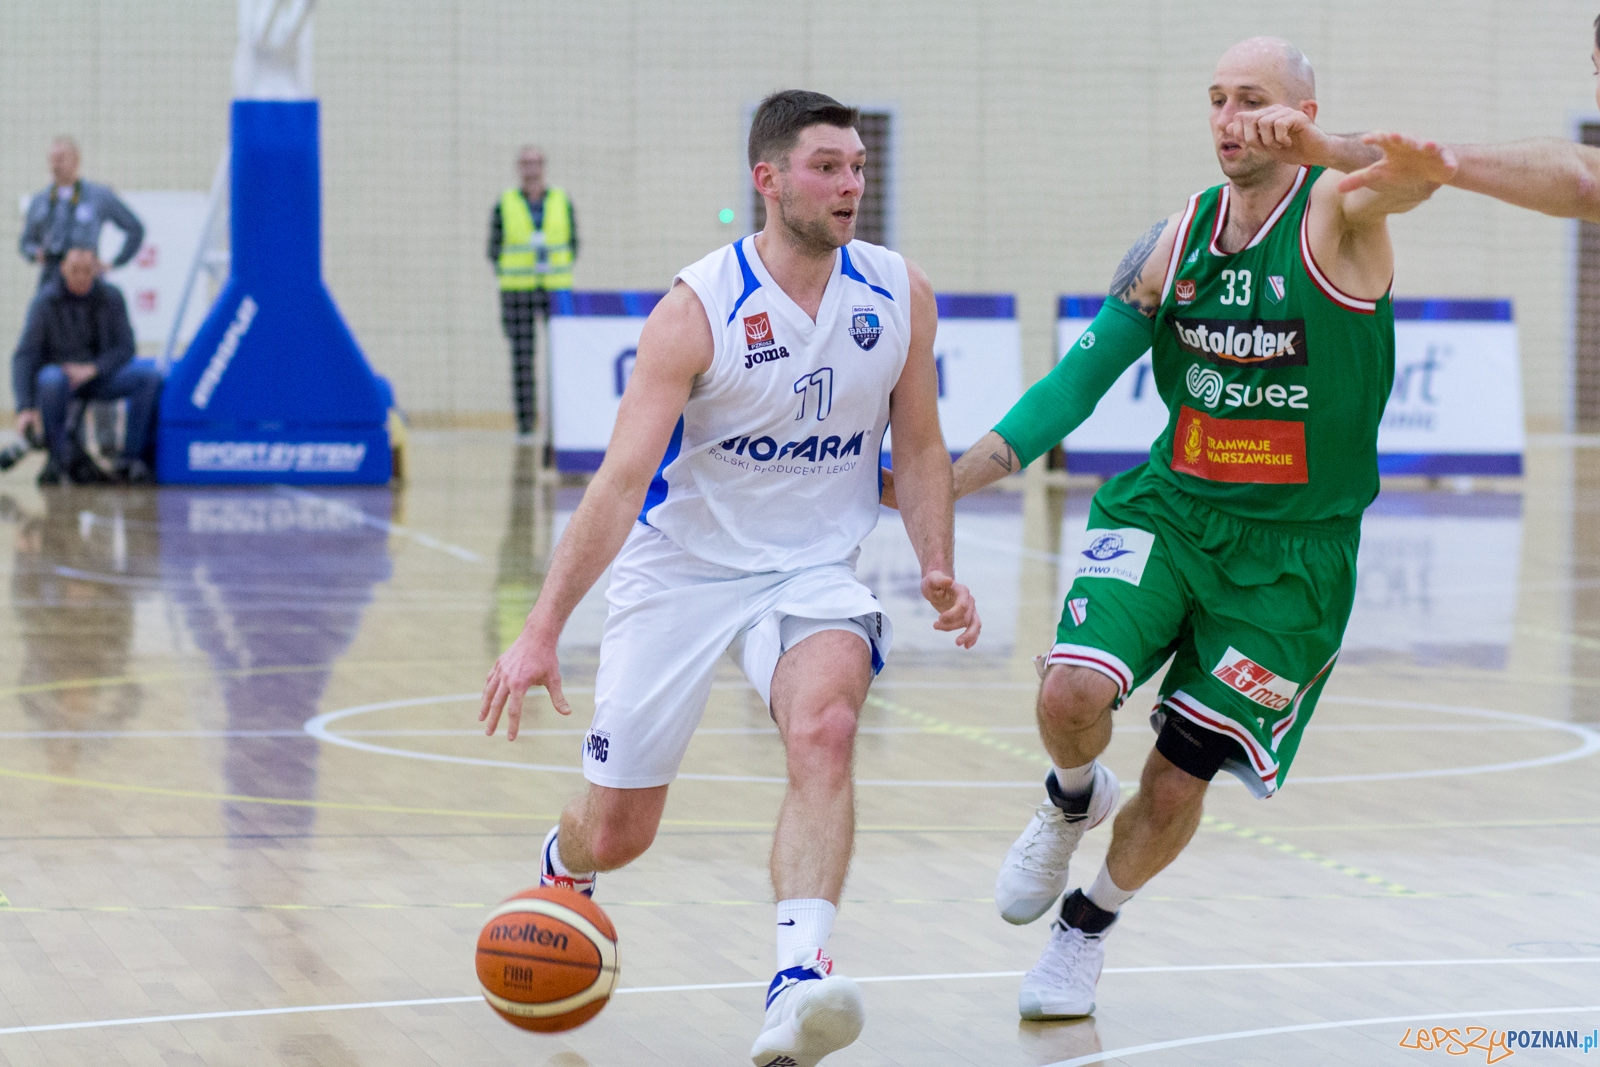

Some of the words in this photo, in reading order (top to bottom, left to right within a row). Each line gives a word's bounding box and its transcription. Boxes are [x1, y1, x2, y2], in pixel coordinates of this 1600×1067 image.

[1220, 269, 1252, 306] 33
[849, 326, 883, 336] BASKET
[1175, 320, 1298, 358] totolotek
[794, 367, 833, 421] 11
[708, 448, 750, 470] POLSKI
[753, 464, 824, 476] PRODUCENT
[1206, 449, 1294, 466] WARSZAWSKIE
[1088, 566, 1111, 574] FWO
[1112, 567, 1138, 581] Polska
[489, 923, 569, 952] molten
[503, 964, 533, 982] FIBA
